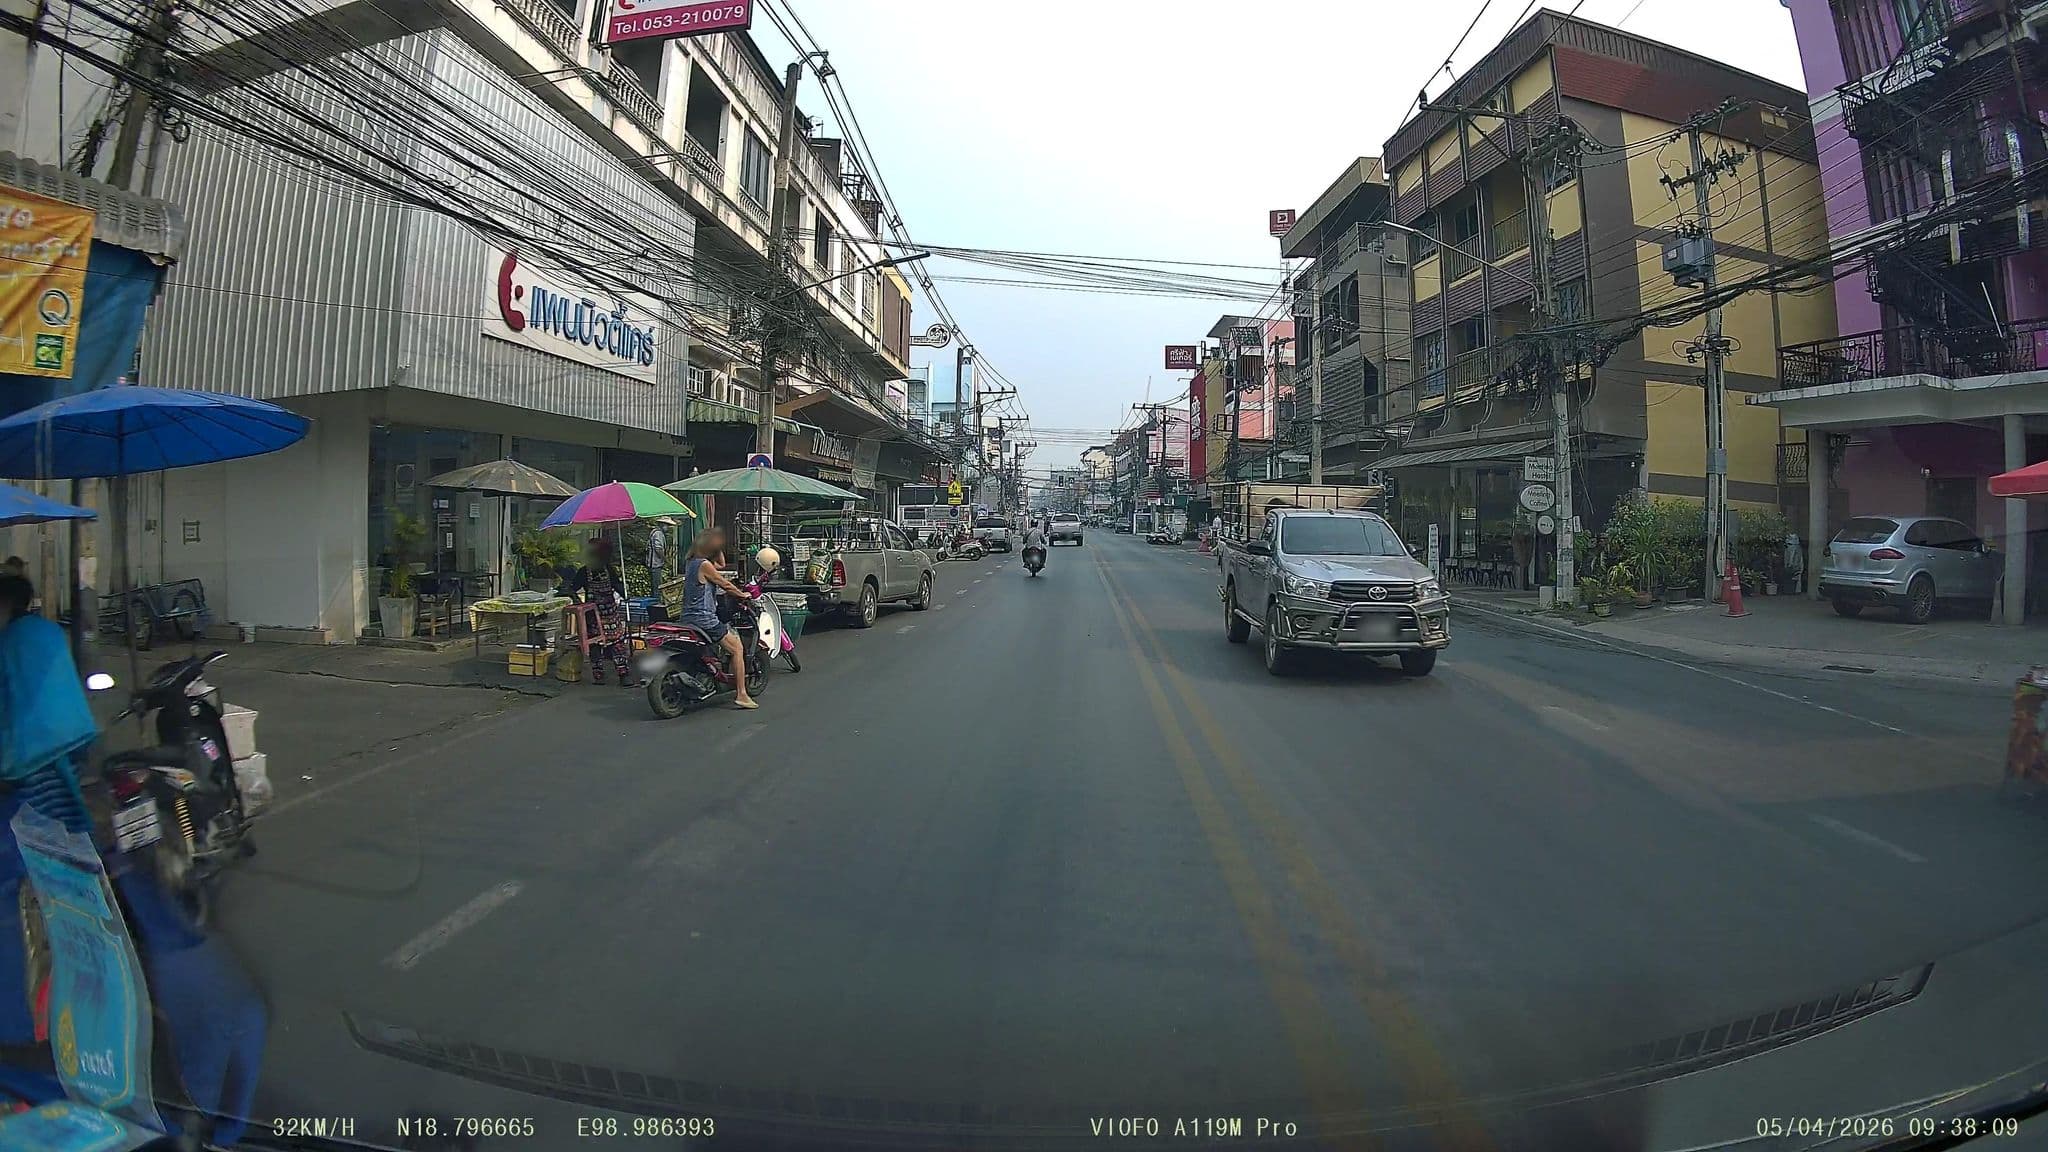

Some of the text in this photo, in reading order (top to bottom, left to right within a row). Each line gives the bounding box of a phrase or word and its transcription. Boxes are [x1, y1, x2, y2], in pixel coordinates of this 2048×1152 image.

[614, 5, 744, 35] Tel.053-210079
[530, 285, 656, 367] แพนบิวตี้แคร์
